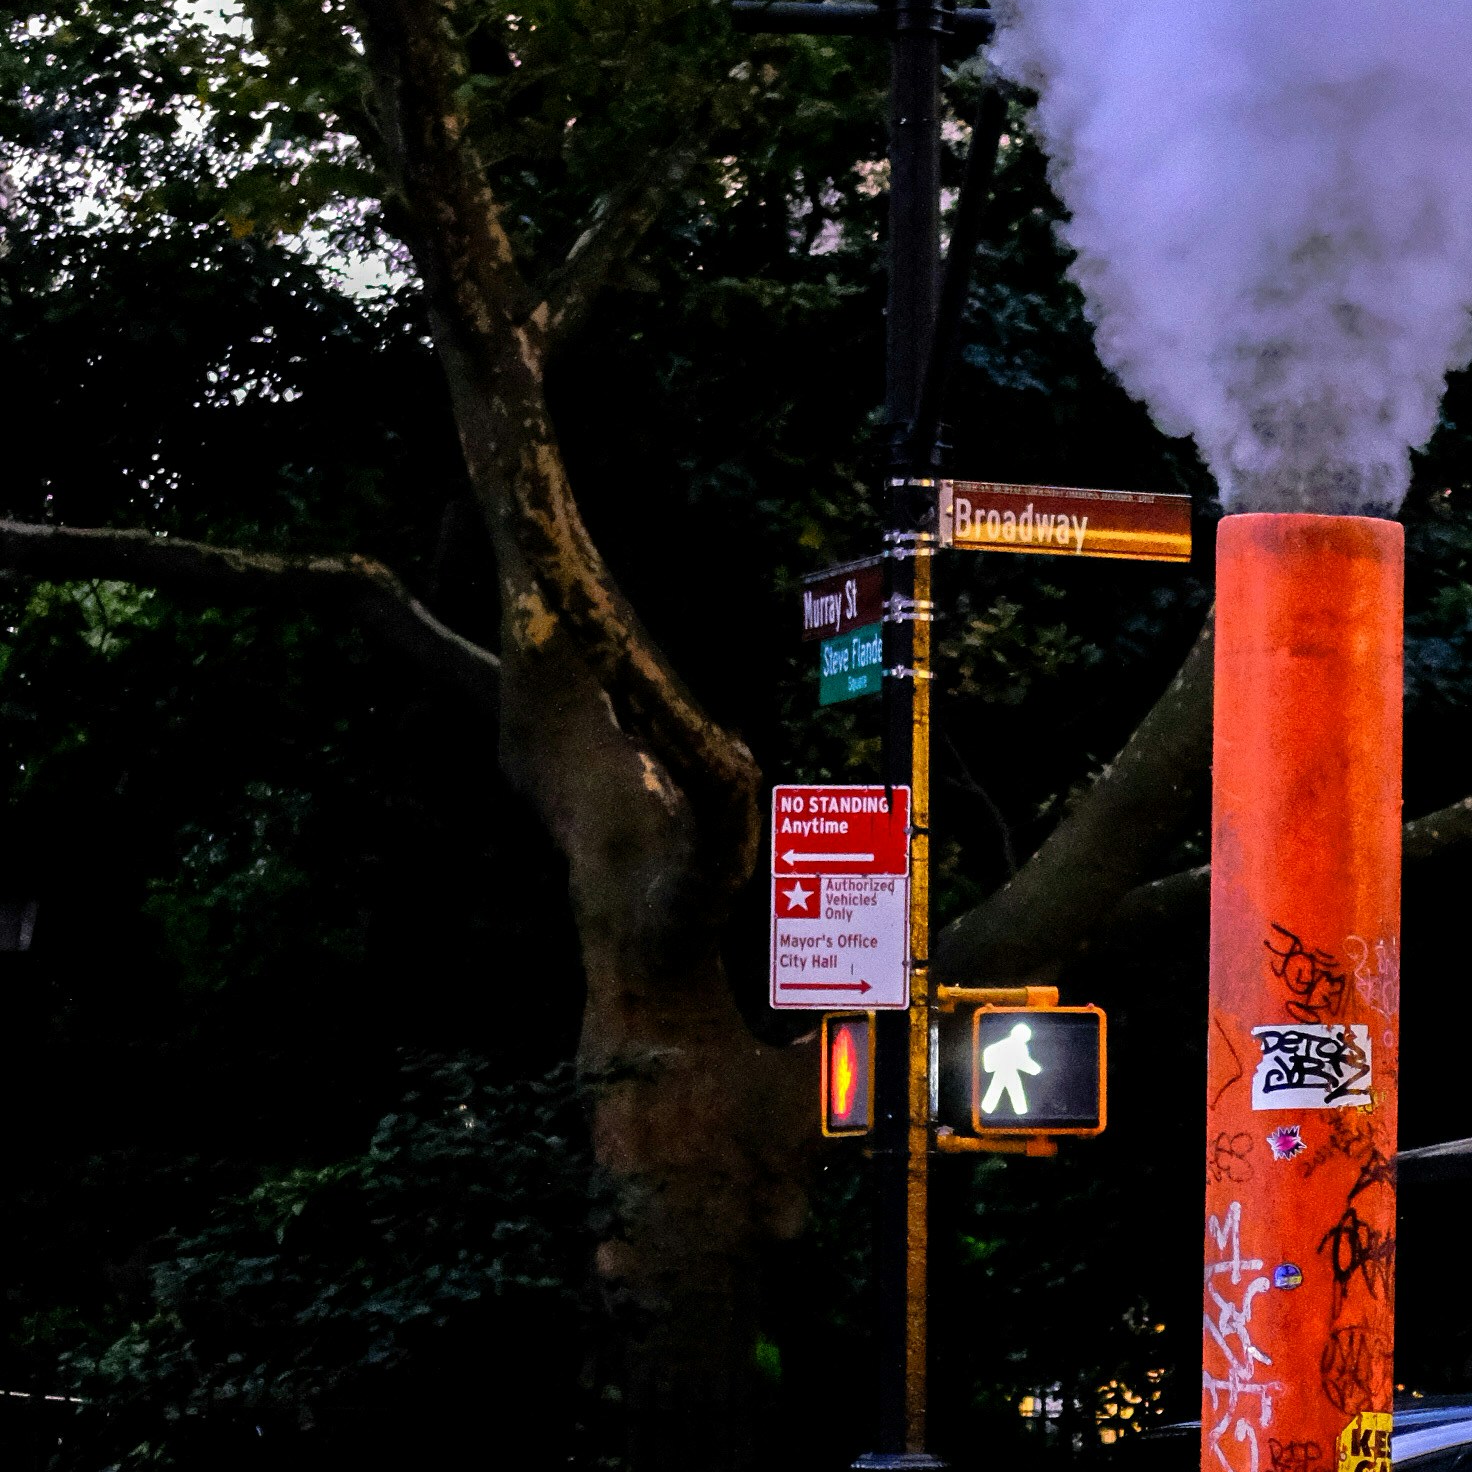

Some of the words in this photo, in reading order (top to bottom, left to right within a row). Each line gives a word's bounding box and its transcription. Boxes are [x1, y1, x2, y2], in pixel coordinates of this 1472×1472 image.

[955, 497, 1088, 555] Broadway
[803, 590, 842, 633] Murray
[845, 579, 858, 620] St
[823, 645, 849, 678] Steve
[781, 796, 804, 814] NO
[809, 796, 890, 814] STANDING
[781, 817, 849, 837] Anytime
[826, 878, 895, 892] Authorized
[826, 893, 878, 906] Vehicles
[825, 907, 853, 923] Only
[780, 934, 833, 951] Mayor's
[837, 934, 878, 949] Office
[780, 954, 807, 971] City
[812, 955, 838, 969] Hall
